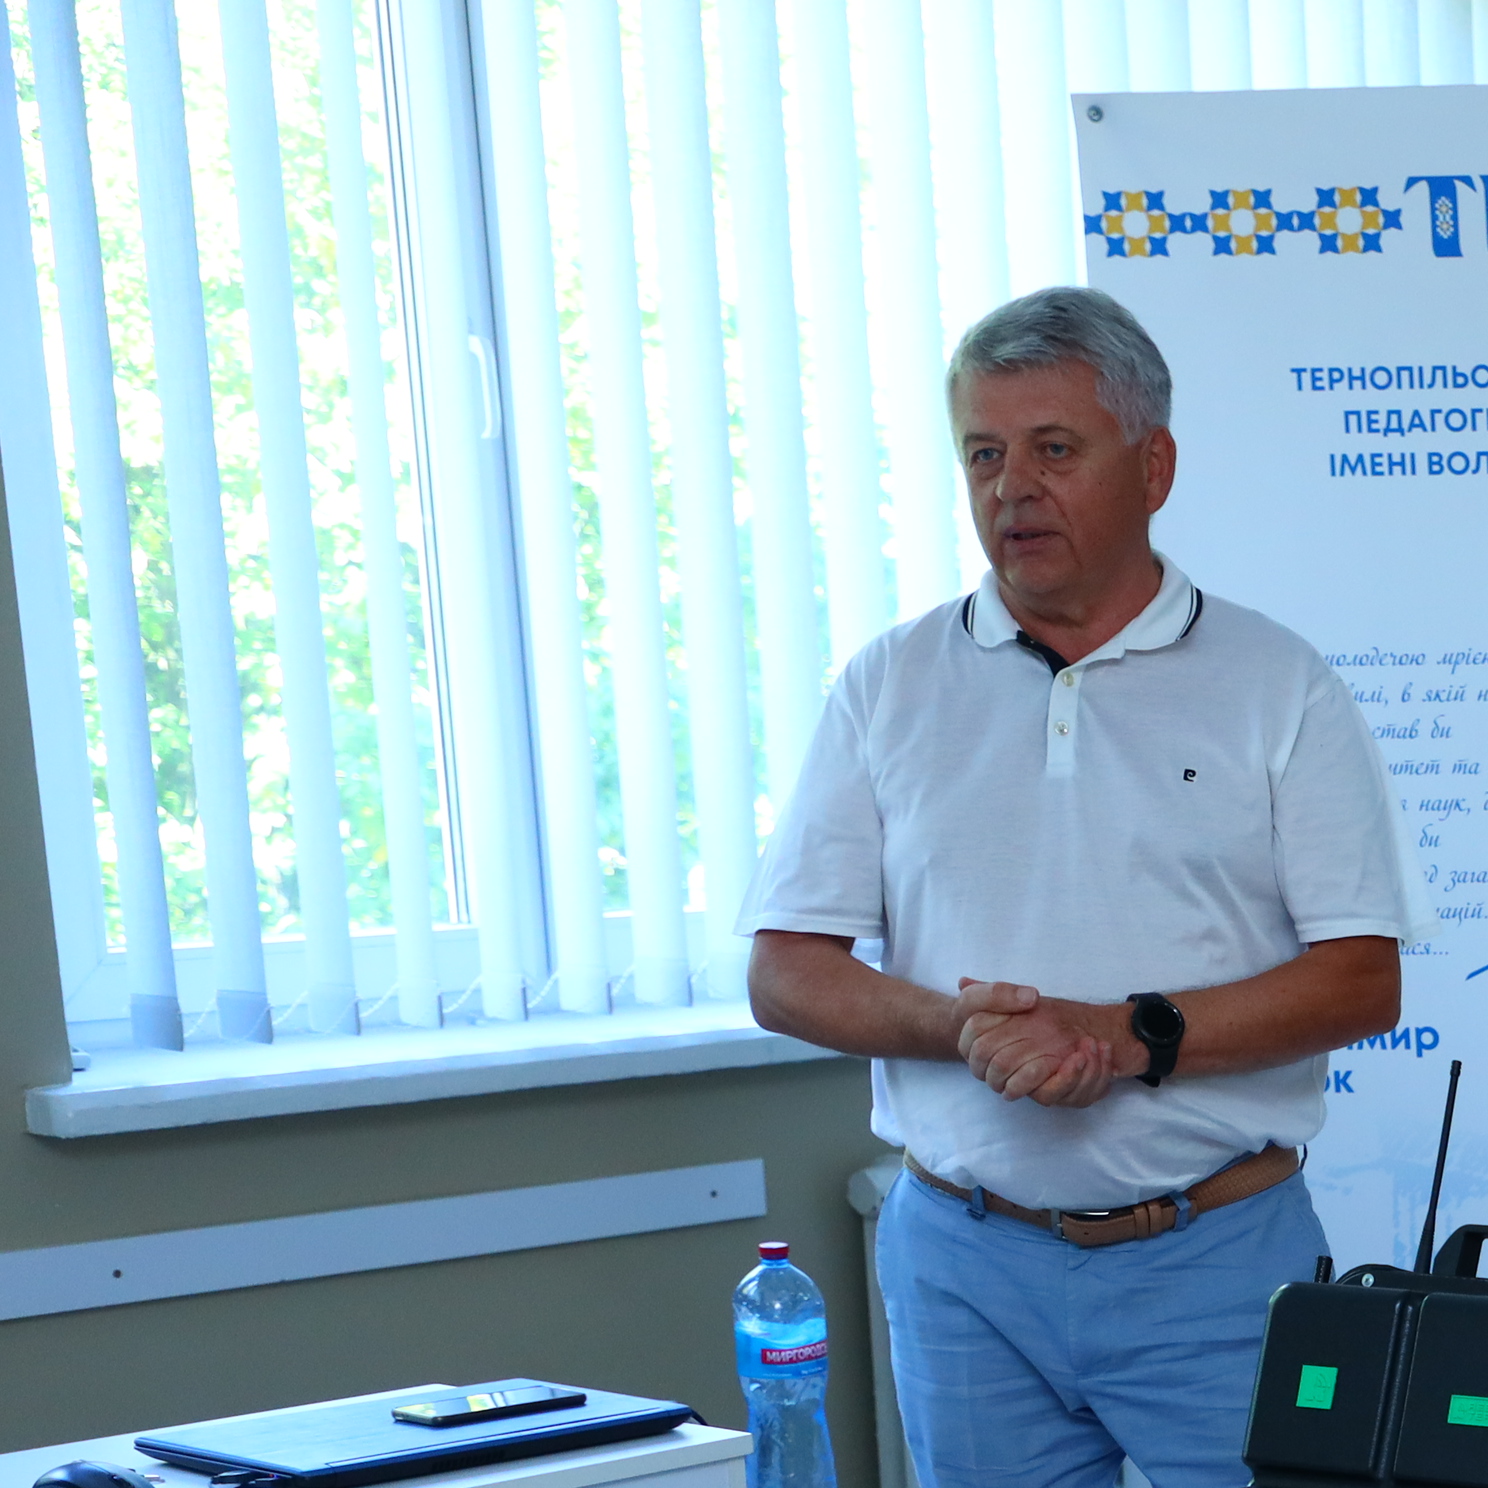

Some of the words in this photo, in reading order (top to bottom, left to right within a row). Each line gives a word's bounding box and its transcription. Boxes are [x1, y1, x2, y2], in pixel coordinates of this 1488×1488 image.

[1329, 452, 1416, 477] ІМЕНІ
[1350, 682, 1389, 708] илі,
[1401, 681, 1413, 703] в
[1421, 684, 1467, 703] якій
[1371, 718, 1421, 740] став
[1430, 714, 1453, 739] би
[1451, 759, 1481, 775] та
[1418, 798, 1472, 821] наук,
[1418, 823, 1441, 848] би
[1436, 901, 1488, 928] ацій.
[1346, 1026, 1440, 1058] мир
